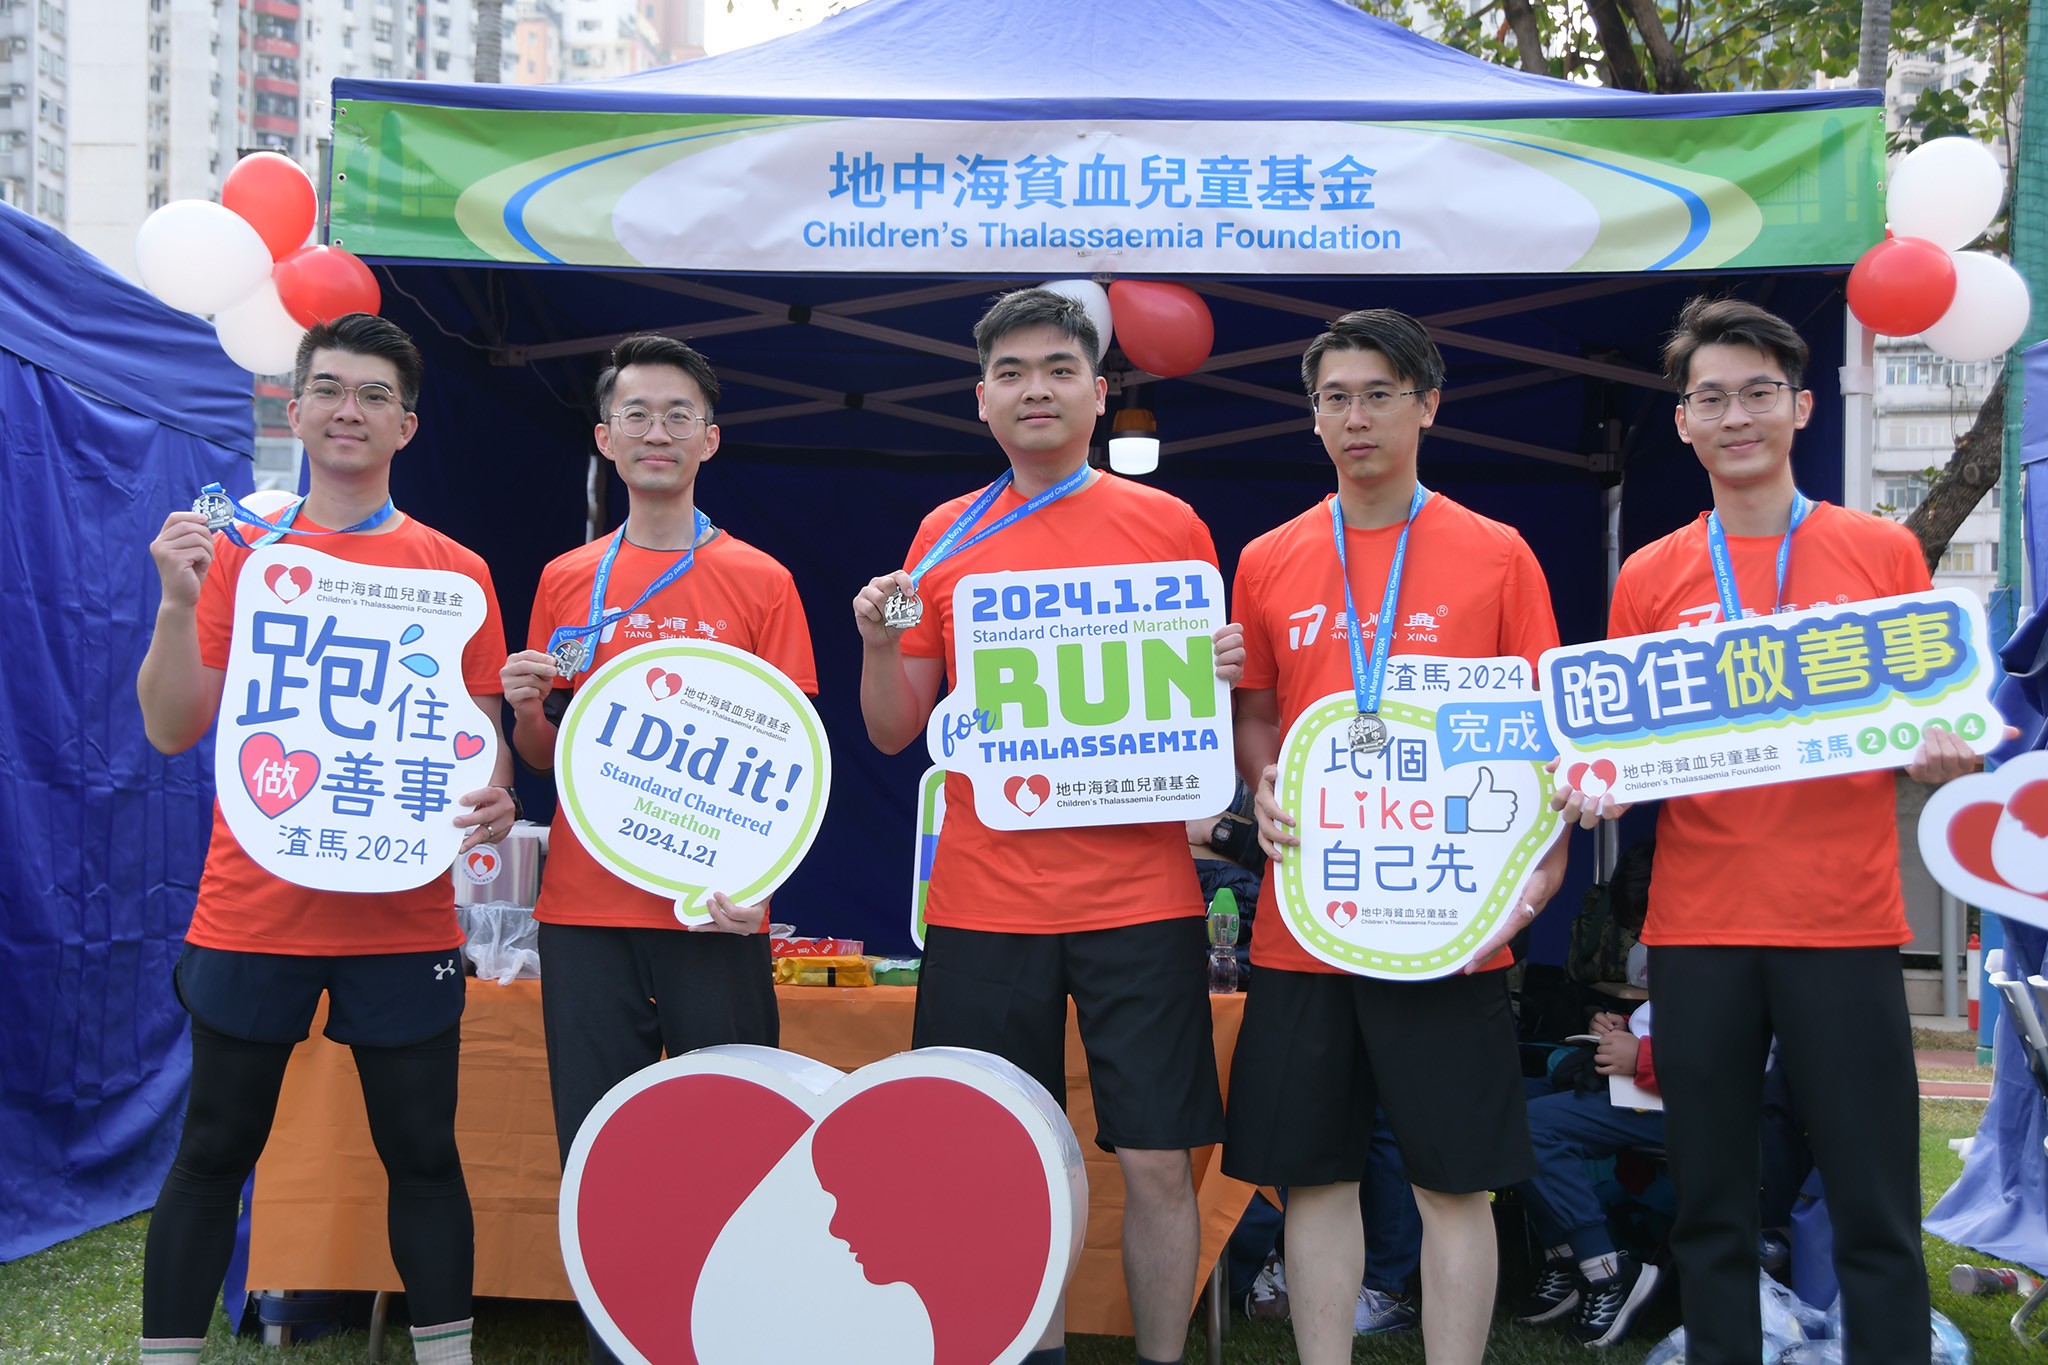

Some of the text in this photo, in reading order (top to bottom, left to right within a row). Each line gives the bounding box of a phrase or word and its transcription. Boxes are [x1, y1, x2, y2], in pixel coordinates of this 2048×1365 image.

[829, 151, 1377, 211] 地中海貧血兒童基金
[978, 221, 1203, 249] Thalassaemia
[1216, 222, 1401, 250] Foundation
[1025, 490, 1054, 511] Standard
[1053, 472, 1080, 495] Chartered
[946, 524, 962, 540] Kong
[957, 512, 973, 529] Hong
[1002, 511, 1018, 524] 2024
[317, 577, 464, 606] 地中海貧血兒童基金
[591, 573, 606, 609] Chartered
[1712, 544, 1726, 577] Standard
[1719, 577, 1736, 614] Chartered
[317, 594, 462, 617] Children's Thalassaemia Foundation
[972, 574, 1210, 622] 2024.1.21
[1382, 588, 1396, 624] Standard
[589, 610, 599, 627] Hon
[973, 616, 1209, 644] Standard Chartered Marathon
[1349, 620, 1358, 639] 2024
[1407, 633, 1437, 642] XING
[1352, 639, 1363, 674] Marathon
[1367, 656, 1383, 693] Marathon
[1375, 636, 1386, 656] 2024
[1561, 611, 1955, 727] 跑住做善事
[973, 636, 1216, 730] RUN
[1387, 663, 1524, 691] 渣馬 2024
[684, 686, 791, 734] 地中海貧血兒童基金
[711, 709, 752, 729] Thalassaemia
[753, 724, 787, 742] Foundation
[941, 706, 996, 758] for
[979, 729, 1219, 763] THALASSAEMIA
[1450, 710, 1541, 753] 完成
[1798, 734, 1853, 764] 渣馬
[595, 701, 803, 811] I Did it!
[1324, 736, 1426, 782] 比個
[1622, 745, 1780, 778] 地中海貧血兒童基金
[1056, 774, 1200, 796] 地中海貧血兒童基金
[1670, 770, 1729, 787] Thalassaemia
[1731, 764, 1781, 778] Foundation
[600, 761, 772, 837] Standard Chartered
[1057, 793, 1201, 807] Children's Thalassaemia Foundation
[1320, 786, 1434, 830] Like
[633, 796, 721, 841] Marathon
[277, 825, 347, 861] 渣馬
[619, 817, 718, 868] 2024.1.21
[1323, 840, 1477, 893] 自己先
[1361, 906, 1459, 919] 地中海貧血兒童基金
